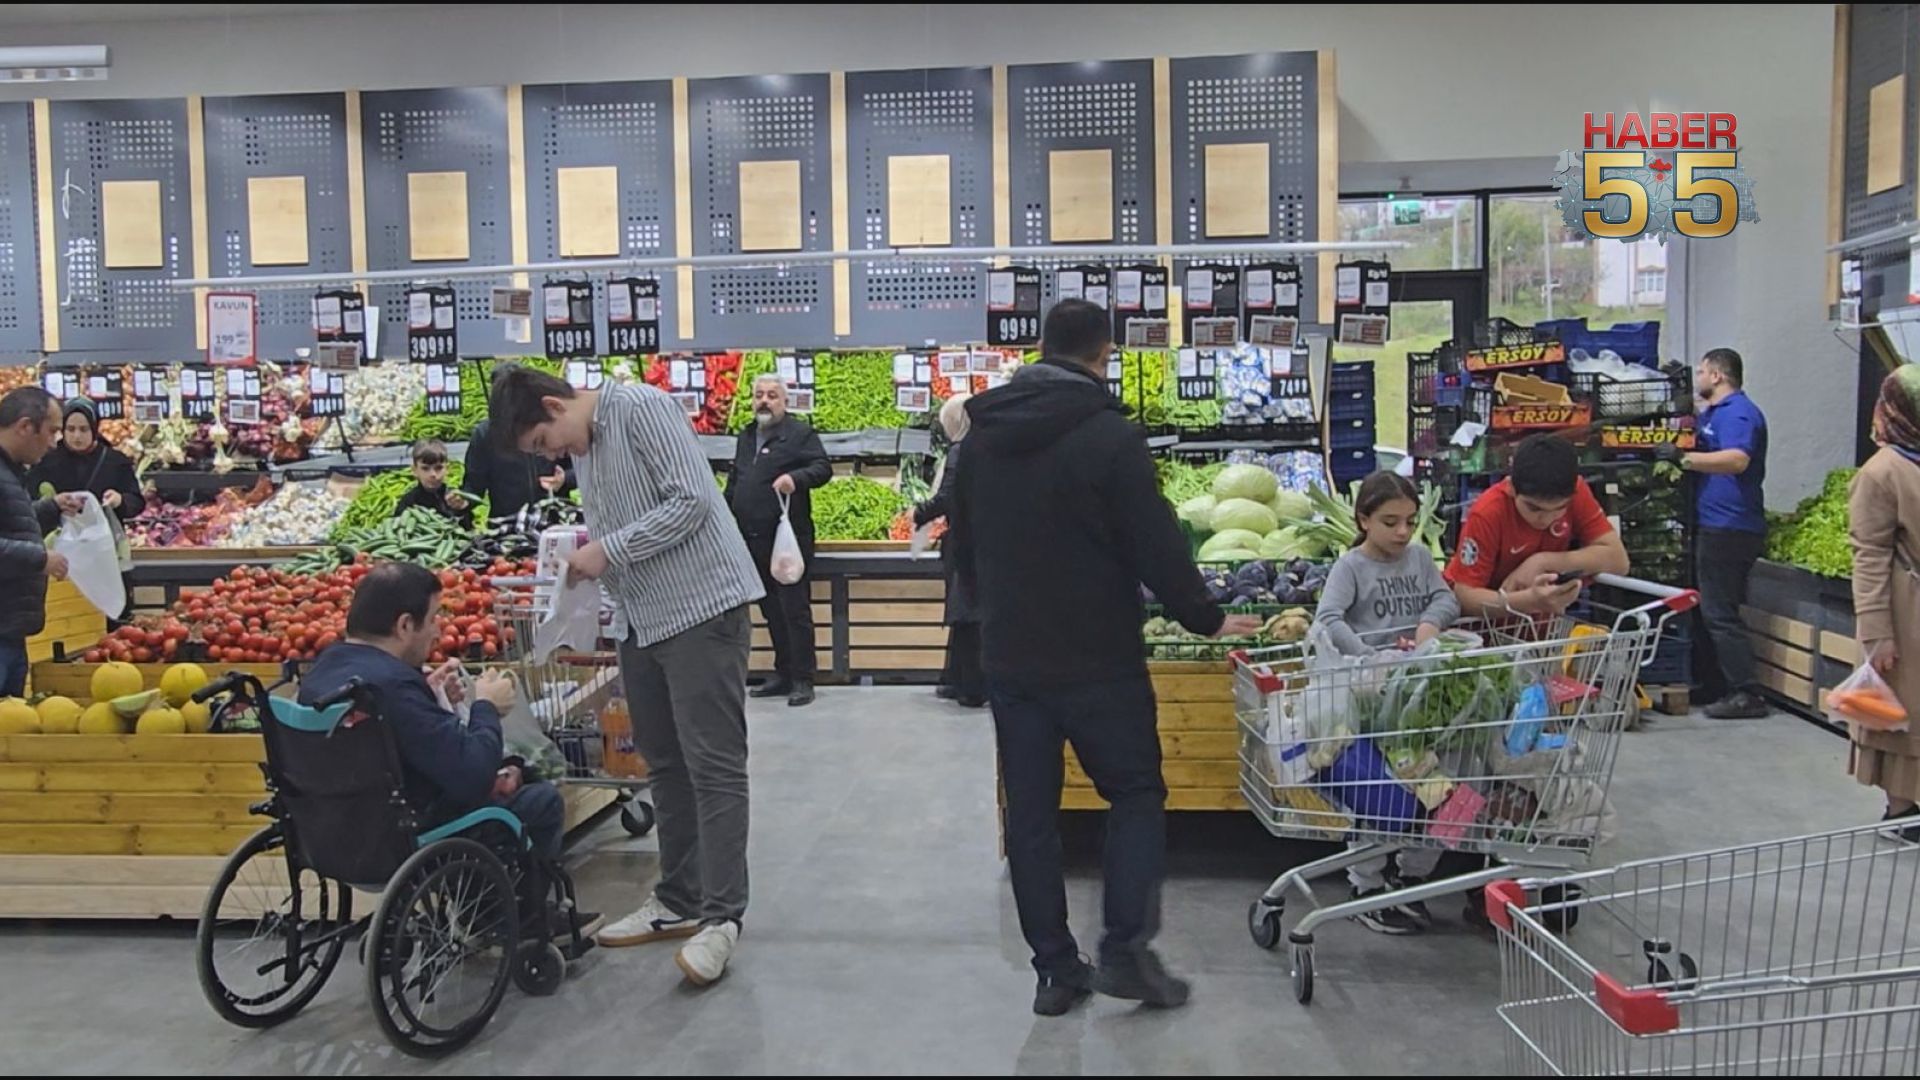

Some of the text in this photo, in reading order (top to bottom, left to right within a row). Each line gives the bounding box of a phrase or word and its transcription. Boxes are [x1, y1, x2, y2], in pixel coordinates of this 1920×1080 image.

[213, 301, 248, 311] KAVUN
[1486, 347, 1545, 364] ERSOY
[1513, 409, 1572, 423] ERSOY
[1618, 430, 1679, 444] ERSOY
[1376, 574, 1422, 597] THINK
